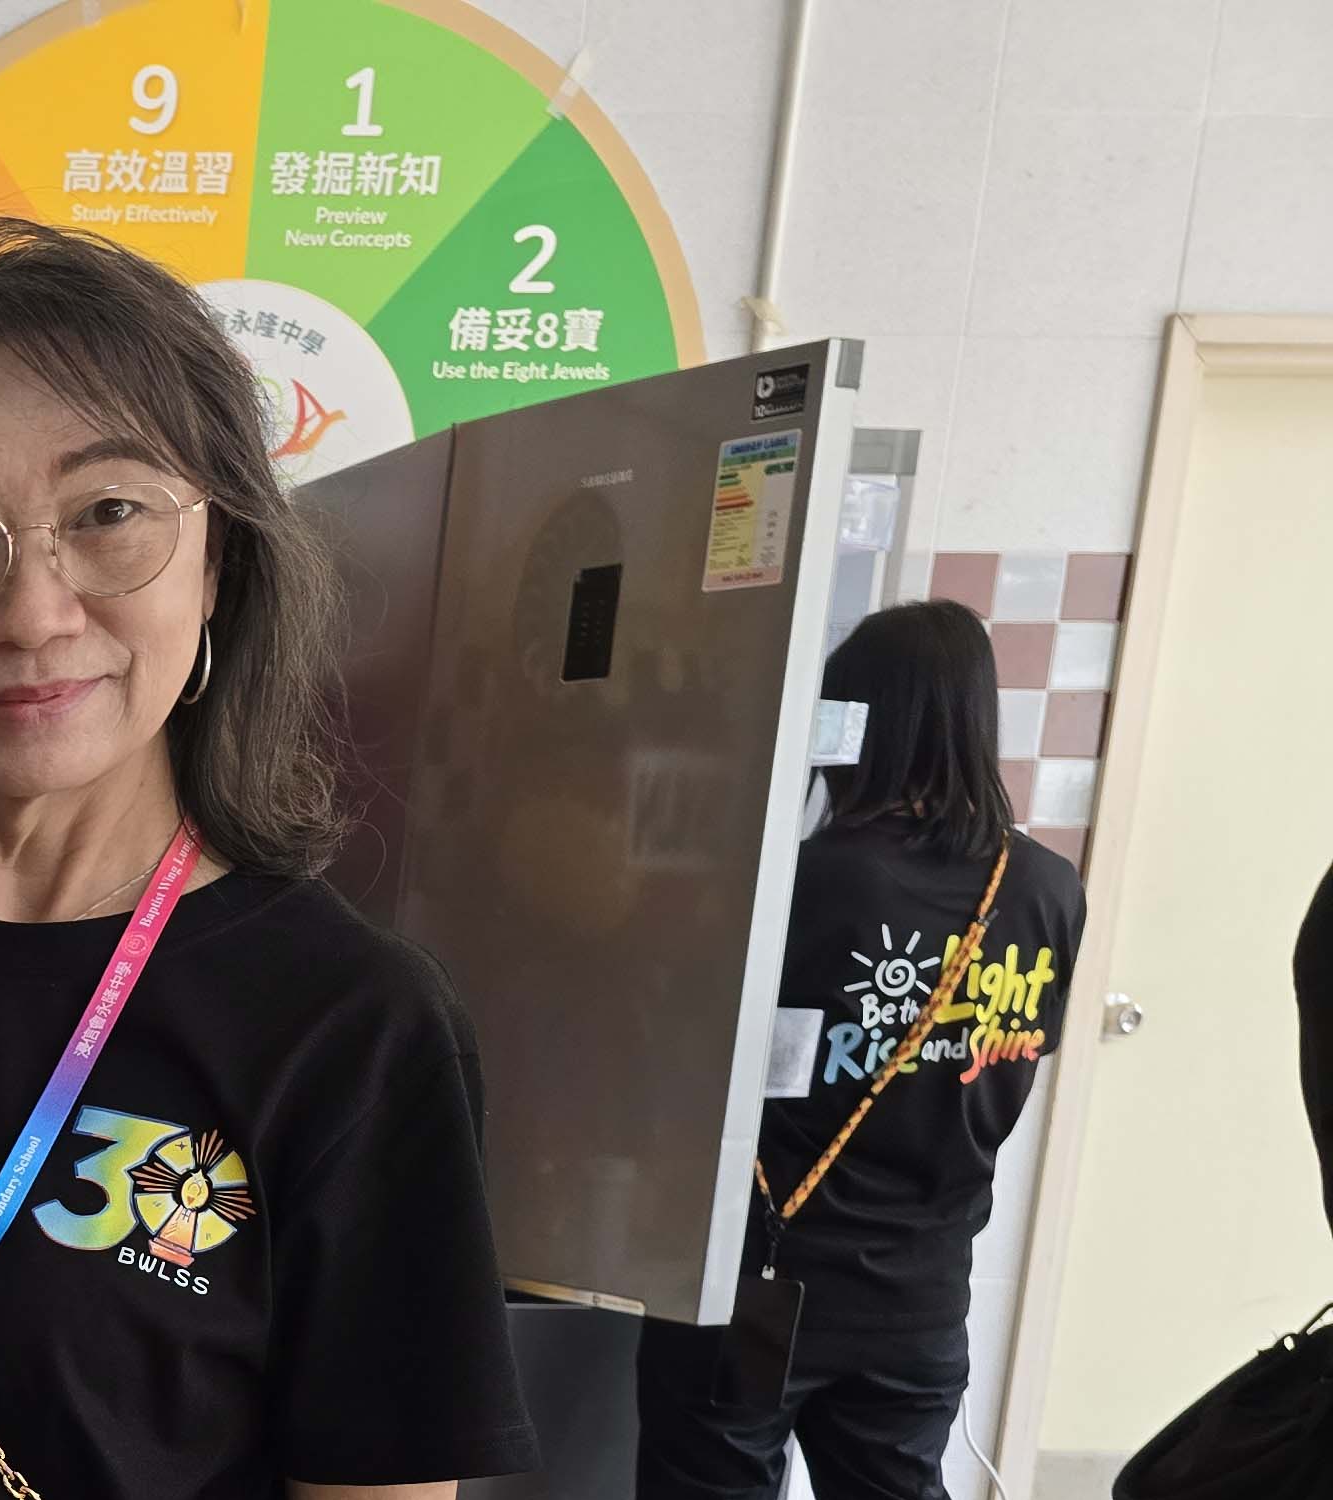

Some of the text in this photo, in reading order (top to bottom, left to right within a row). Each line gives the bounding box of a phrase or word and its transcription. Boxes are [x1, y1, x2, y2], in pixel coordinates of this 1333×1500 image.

[129, 65, 178, 135] 9
[341, 67, 384, 136] 1
[63, 149, 233, 194] 高效溫習
[270, 151, 441, 196] 發掘新知
[71, 204, 218, 225] Study Effectively
[315, 207, 387, 225] Preview
[285, 230, 412, 250] New Concepts
[509, 225, 557, 293] 2
[449, 307, 604, 351] 備妥8寶
[433, 362, 610, 382] Use the Eight Jewels
[139, 890, 161, 929] Baptist
[158, 863, 183, 895] Wing
[860, 993, 897, 1029] Be
[935, 934, 1055, 1024] Light
[73, 960, 133, 1059] 浸信會永隆中學
[921, 1027, 970, 1062] and
[960, 1015, 1045, 1084] Shine
[12, 1136, 42, 1179] School
[117, 1247, 210, 1295] BWLSS
